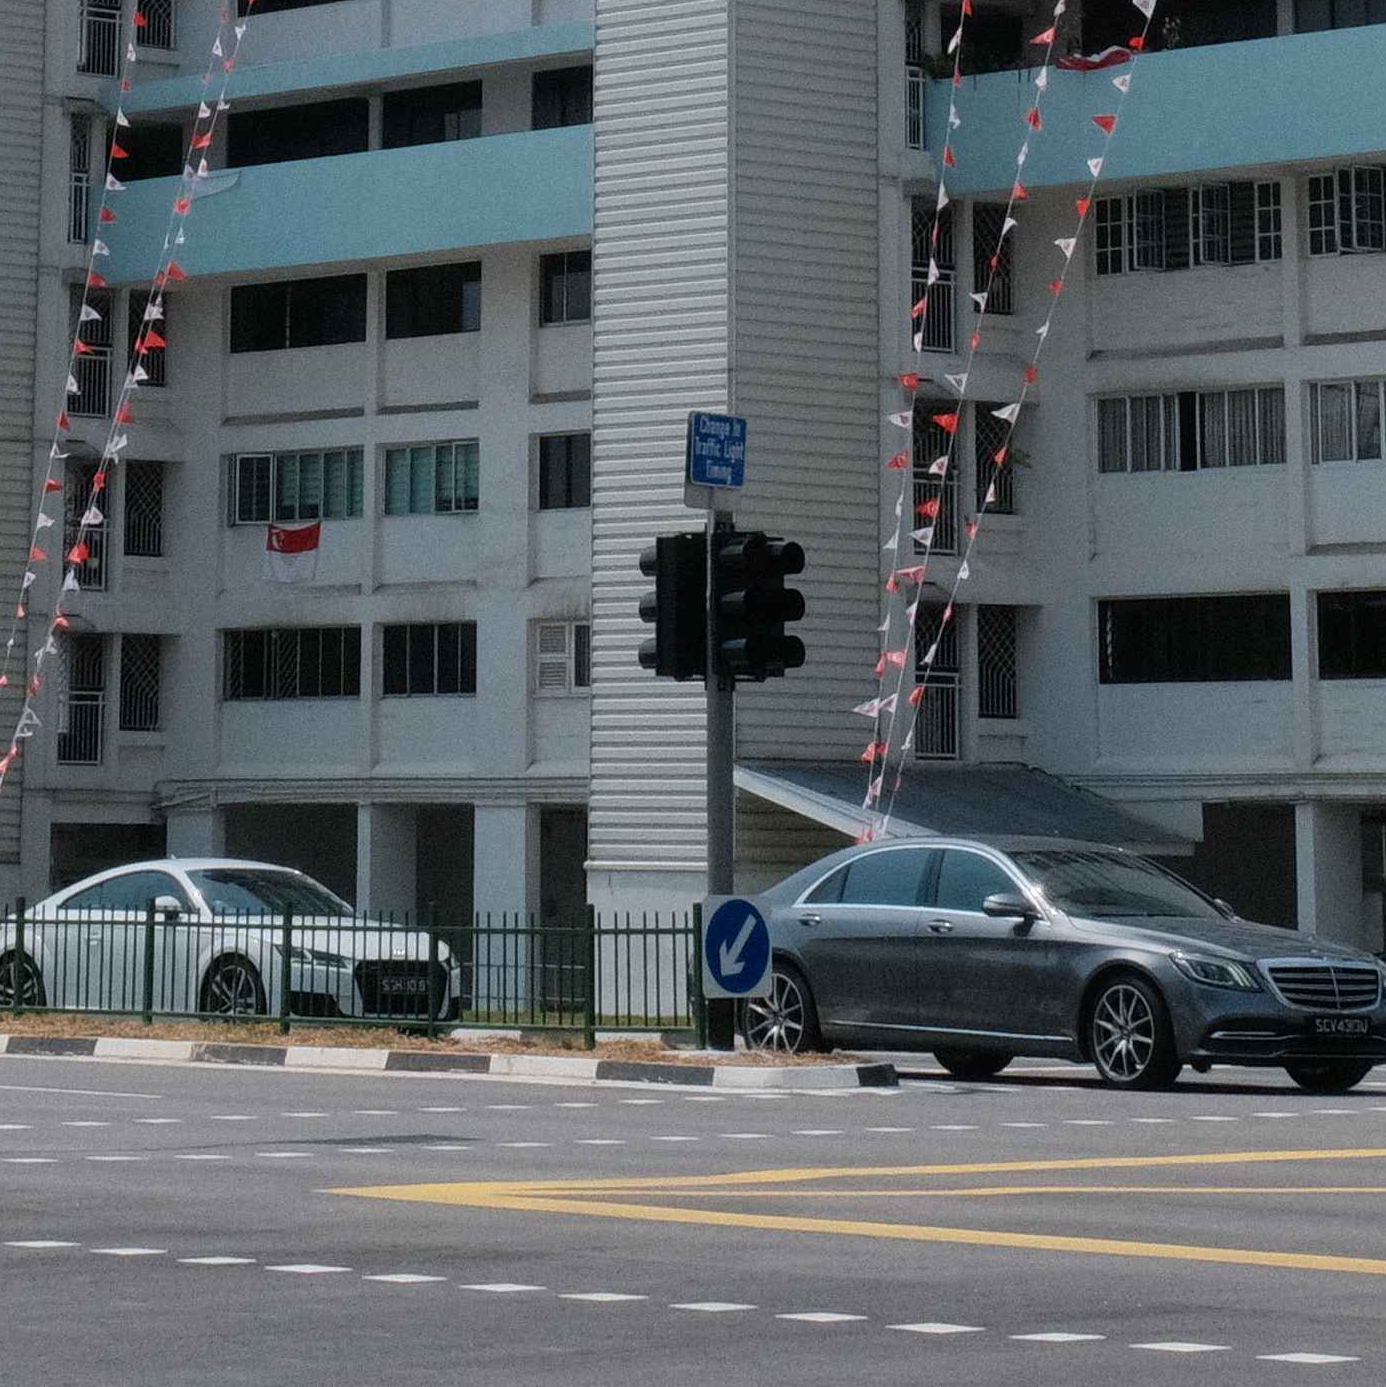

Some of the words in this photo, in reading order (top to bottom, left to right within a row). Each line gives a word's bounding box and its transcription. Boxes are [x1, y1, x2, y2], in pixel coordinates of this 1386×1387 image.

[700, 416, 730, 439] Change
[695, 435, 721, 458] Traffic
[723, 439, 744, 464] Light
